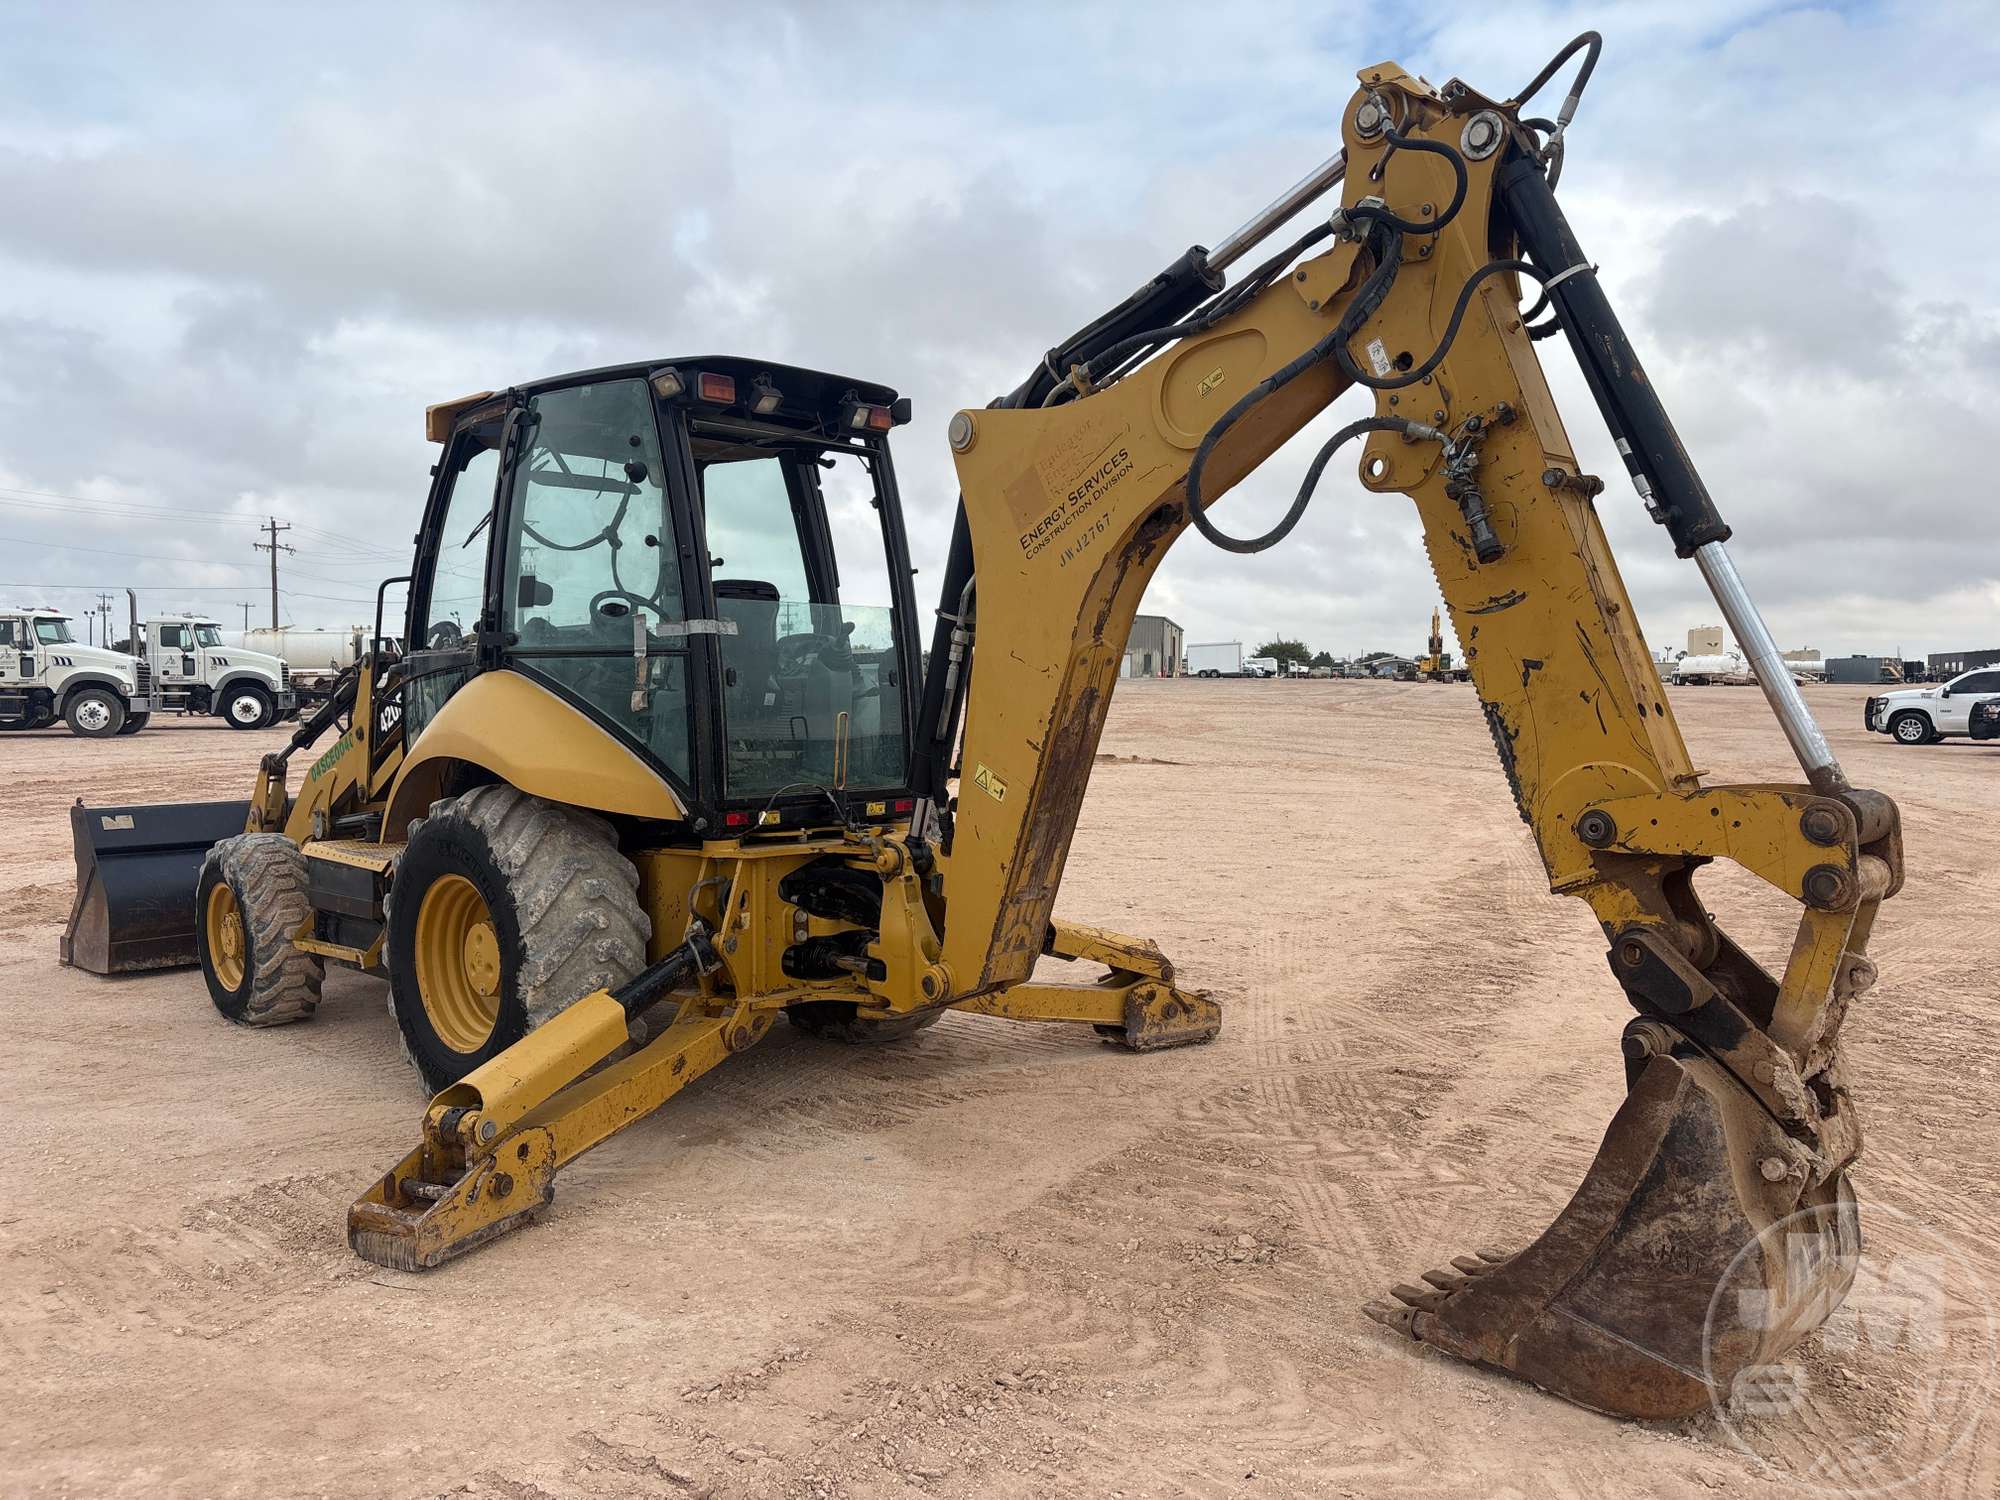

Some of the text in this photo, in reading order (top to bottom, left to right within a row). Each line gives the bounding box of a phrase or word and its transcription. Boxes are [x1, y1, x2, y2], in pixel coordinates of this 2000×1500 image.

[1019, 502, 1067, 550] ENERGY
[1067, 448, 1129, 507] SERVICES
[1025, 500, 1092, 561] CONSTRUCTION
[1092, 461, 1134, 501] DIVISION
